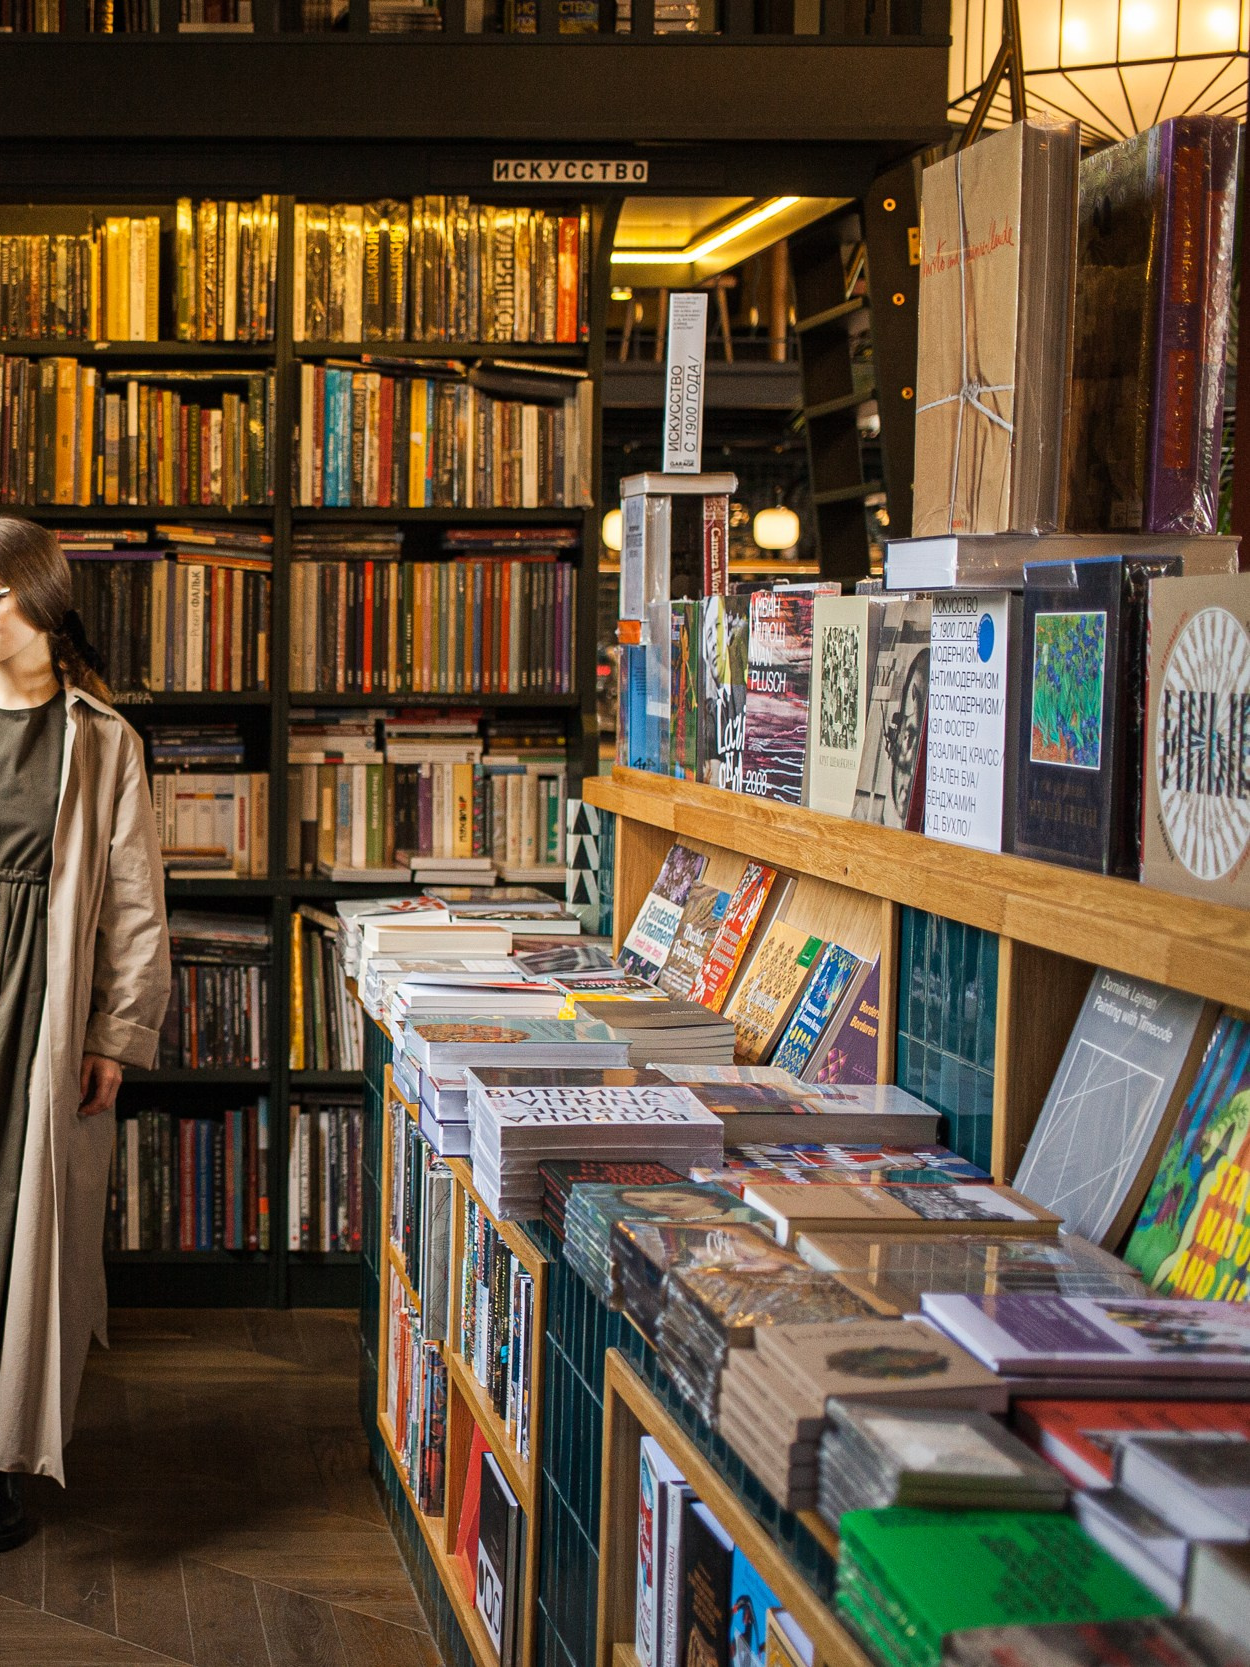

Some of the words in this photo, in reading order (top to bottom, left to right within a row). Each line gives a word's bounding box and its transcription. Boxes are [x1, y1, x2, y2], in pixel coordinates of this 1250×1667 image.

[495, 162, 645, 180] ИСКУССТВО
[668, 365, 683, 452] ИСКУССТВО
[686, 406, 698, 439] 1900
[685, 442, 696, 453] С
[711, 527, 722, 569] Camera
[190, 571, 201, 607] ФАЛЬК
[932, 595, 978, 614] ИСКУССТВО
[932, 624, 938, 638] С
[939, 622, 956, 639] 1900
[931, 646, 979, 665] МОДЕРНИЗМ
[751, 671, 786, 693] PLUSCH
[930, 670, 999, 690] АНТИМОДЕРНИЗМ
[112, 692, 153, 704] АНГАРД
[928, 718, 942, 735] ХЭЛ
[928, 741, 967, 762] РОЗАЛИНД
[927, 766, 959, 785] ИВ-АЛЕН
[927, 789, 977, 813] БЕНДЖАМИН
[647, 900, 680, 932] Fantastic
[1101, 975, 1130, 1003] Dominik
[1130, 987, 1158, 1012] Lejman
[1093, 995, 1122, 1023] Painting
[1122, 1006, 1138, 1029] with
[1138, 1013, 1174, 1043] Timecode
[484, 1089, 668, 1099] ВИТРИНА
[516, 1098, 664, 1106] VITRINE
[502, 1114, 690, 1123] ВИТРИНА
[526, 1107, 676, 1115] VITRINE
[1209, 1160, 1250, 1214] STA
[1196, 1208, 1250, 1272] NATU
[664, 1545, 675, 1595] ПРОЙТИ
[663, 1599, 674, 1649] СКВОЗЬ
